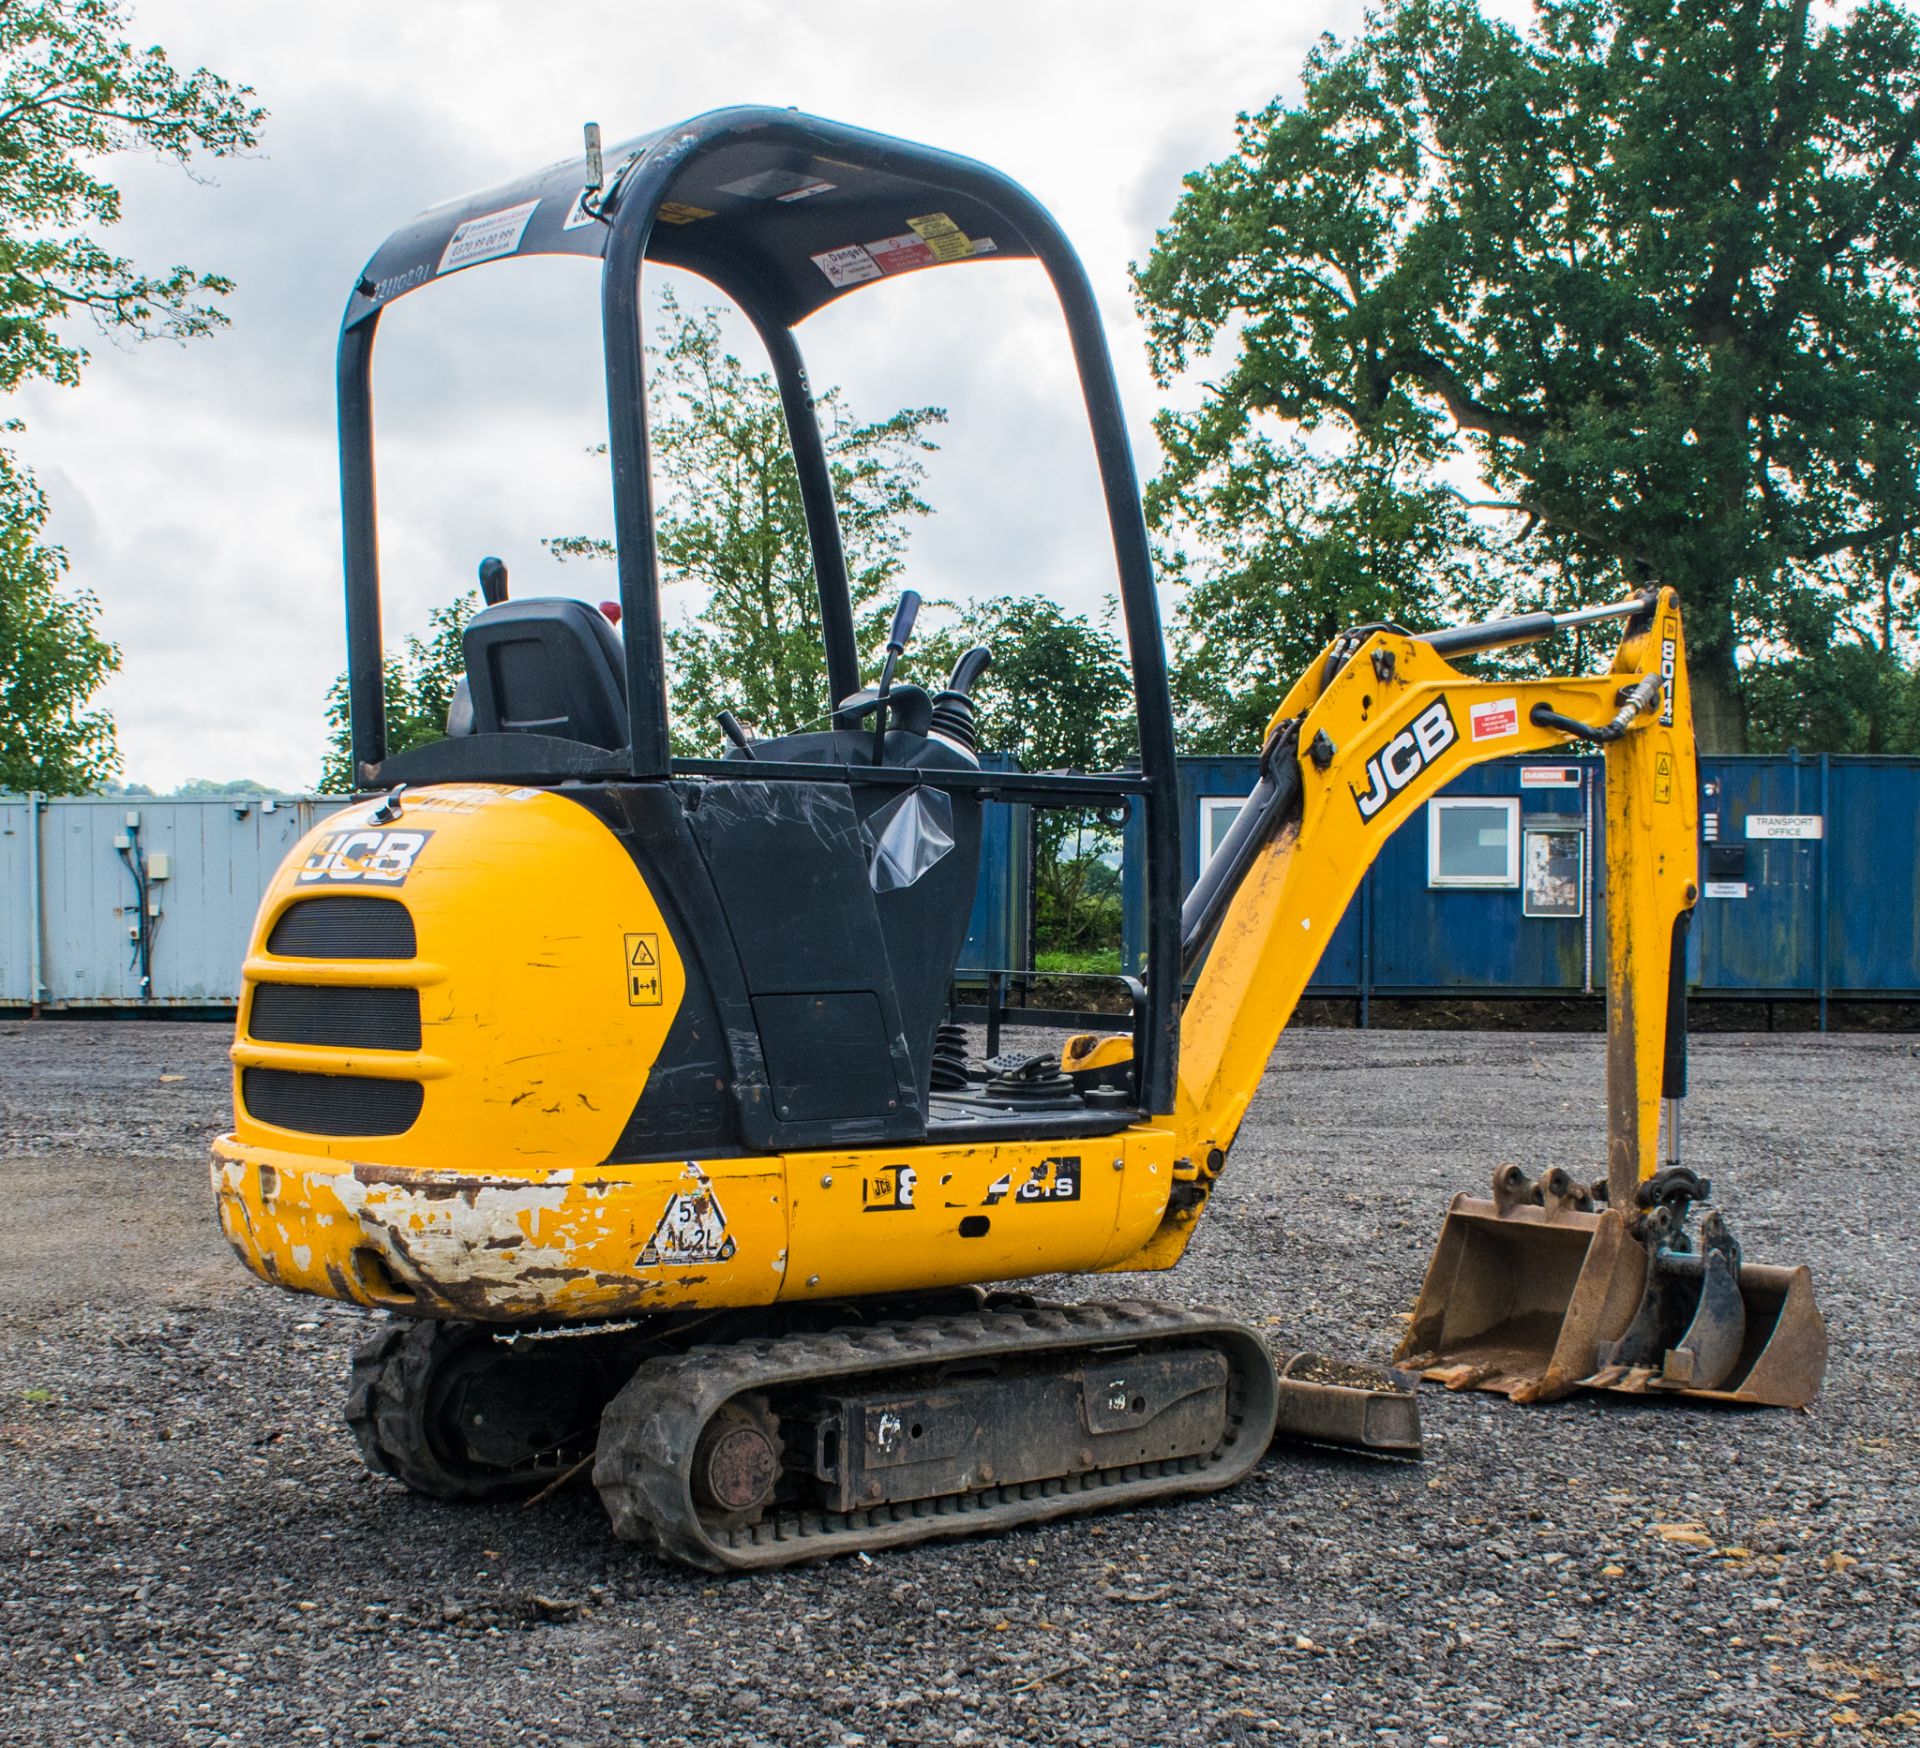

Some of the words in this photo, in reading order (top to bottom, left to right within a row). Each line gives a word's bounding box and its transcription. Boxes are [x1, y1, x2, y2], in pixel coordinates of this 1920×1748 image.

[828, 246, 864, 264] Danger
[1661, 640, 1676, 717] 8014
[1358, 703, 1454, 816] JCB
[1756, 817, 1814, 826] TRANSPORT
[1767, 828, 1802, 836] OFFICE
[300, 832, 425, 881] JCB
[874, 1177, 892, 1197] JCB
